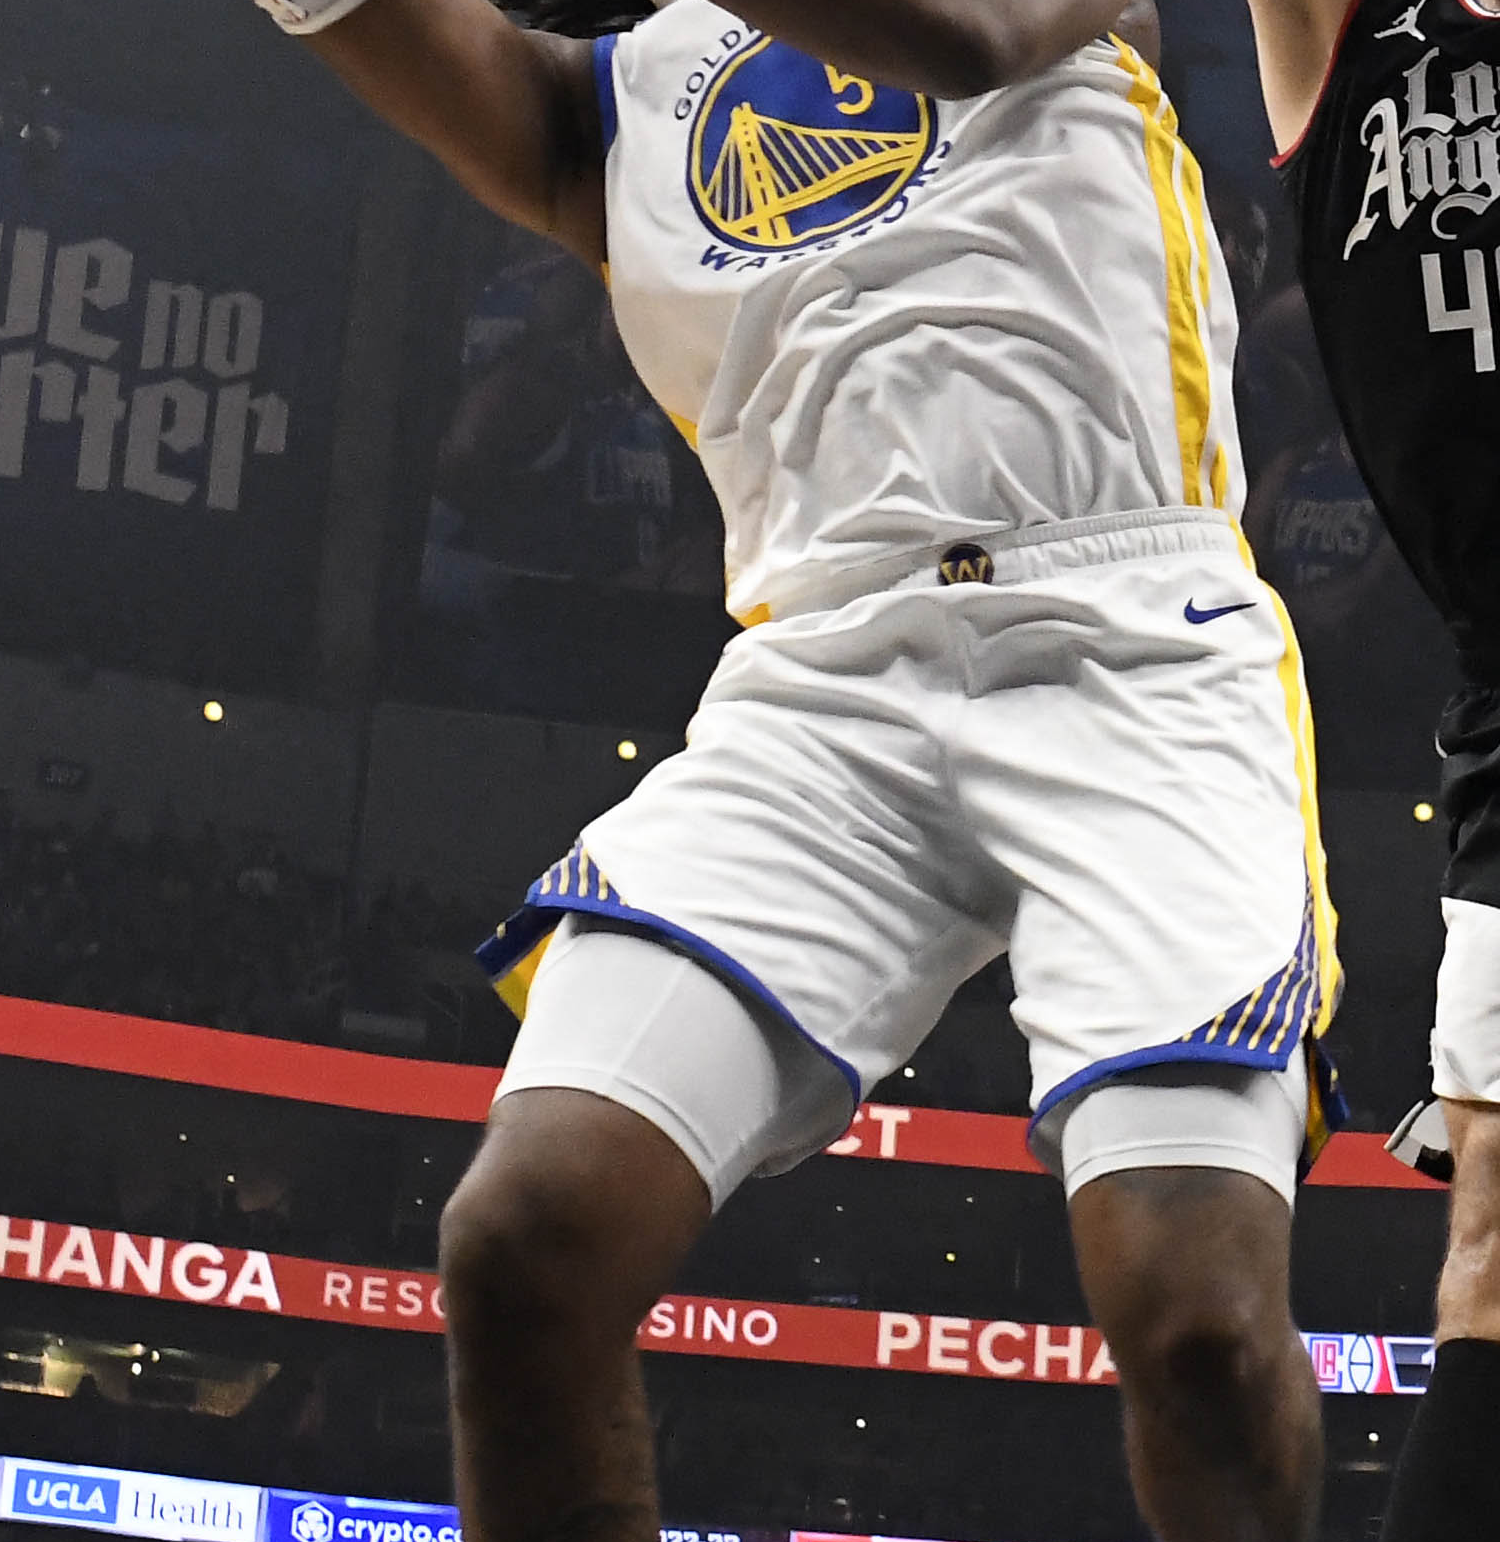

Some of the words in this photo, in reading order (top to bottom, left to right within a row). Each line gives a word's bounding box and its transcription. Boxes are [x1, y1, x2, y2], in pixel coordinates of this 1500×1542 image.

[140, 278, 264, 378] no
[639, 1303, 778, 1346] SINO
[876, 1311, 1119, 1381] PECHA
[26, 1477, 108, 1516] UCLA
[132, 1489, 245, 1532] Health
